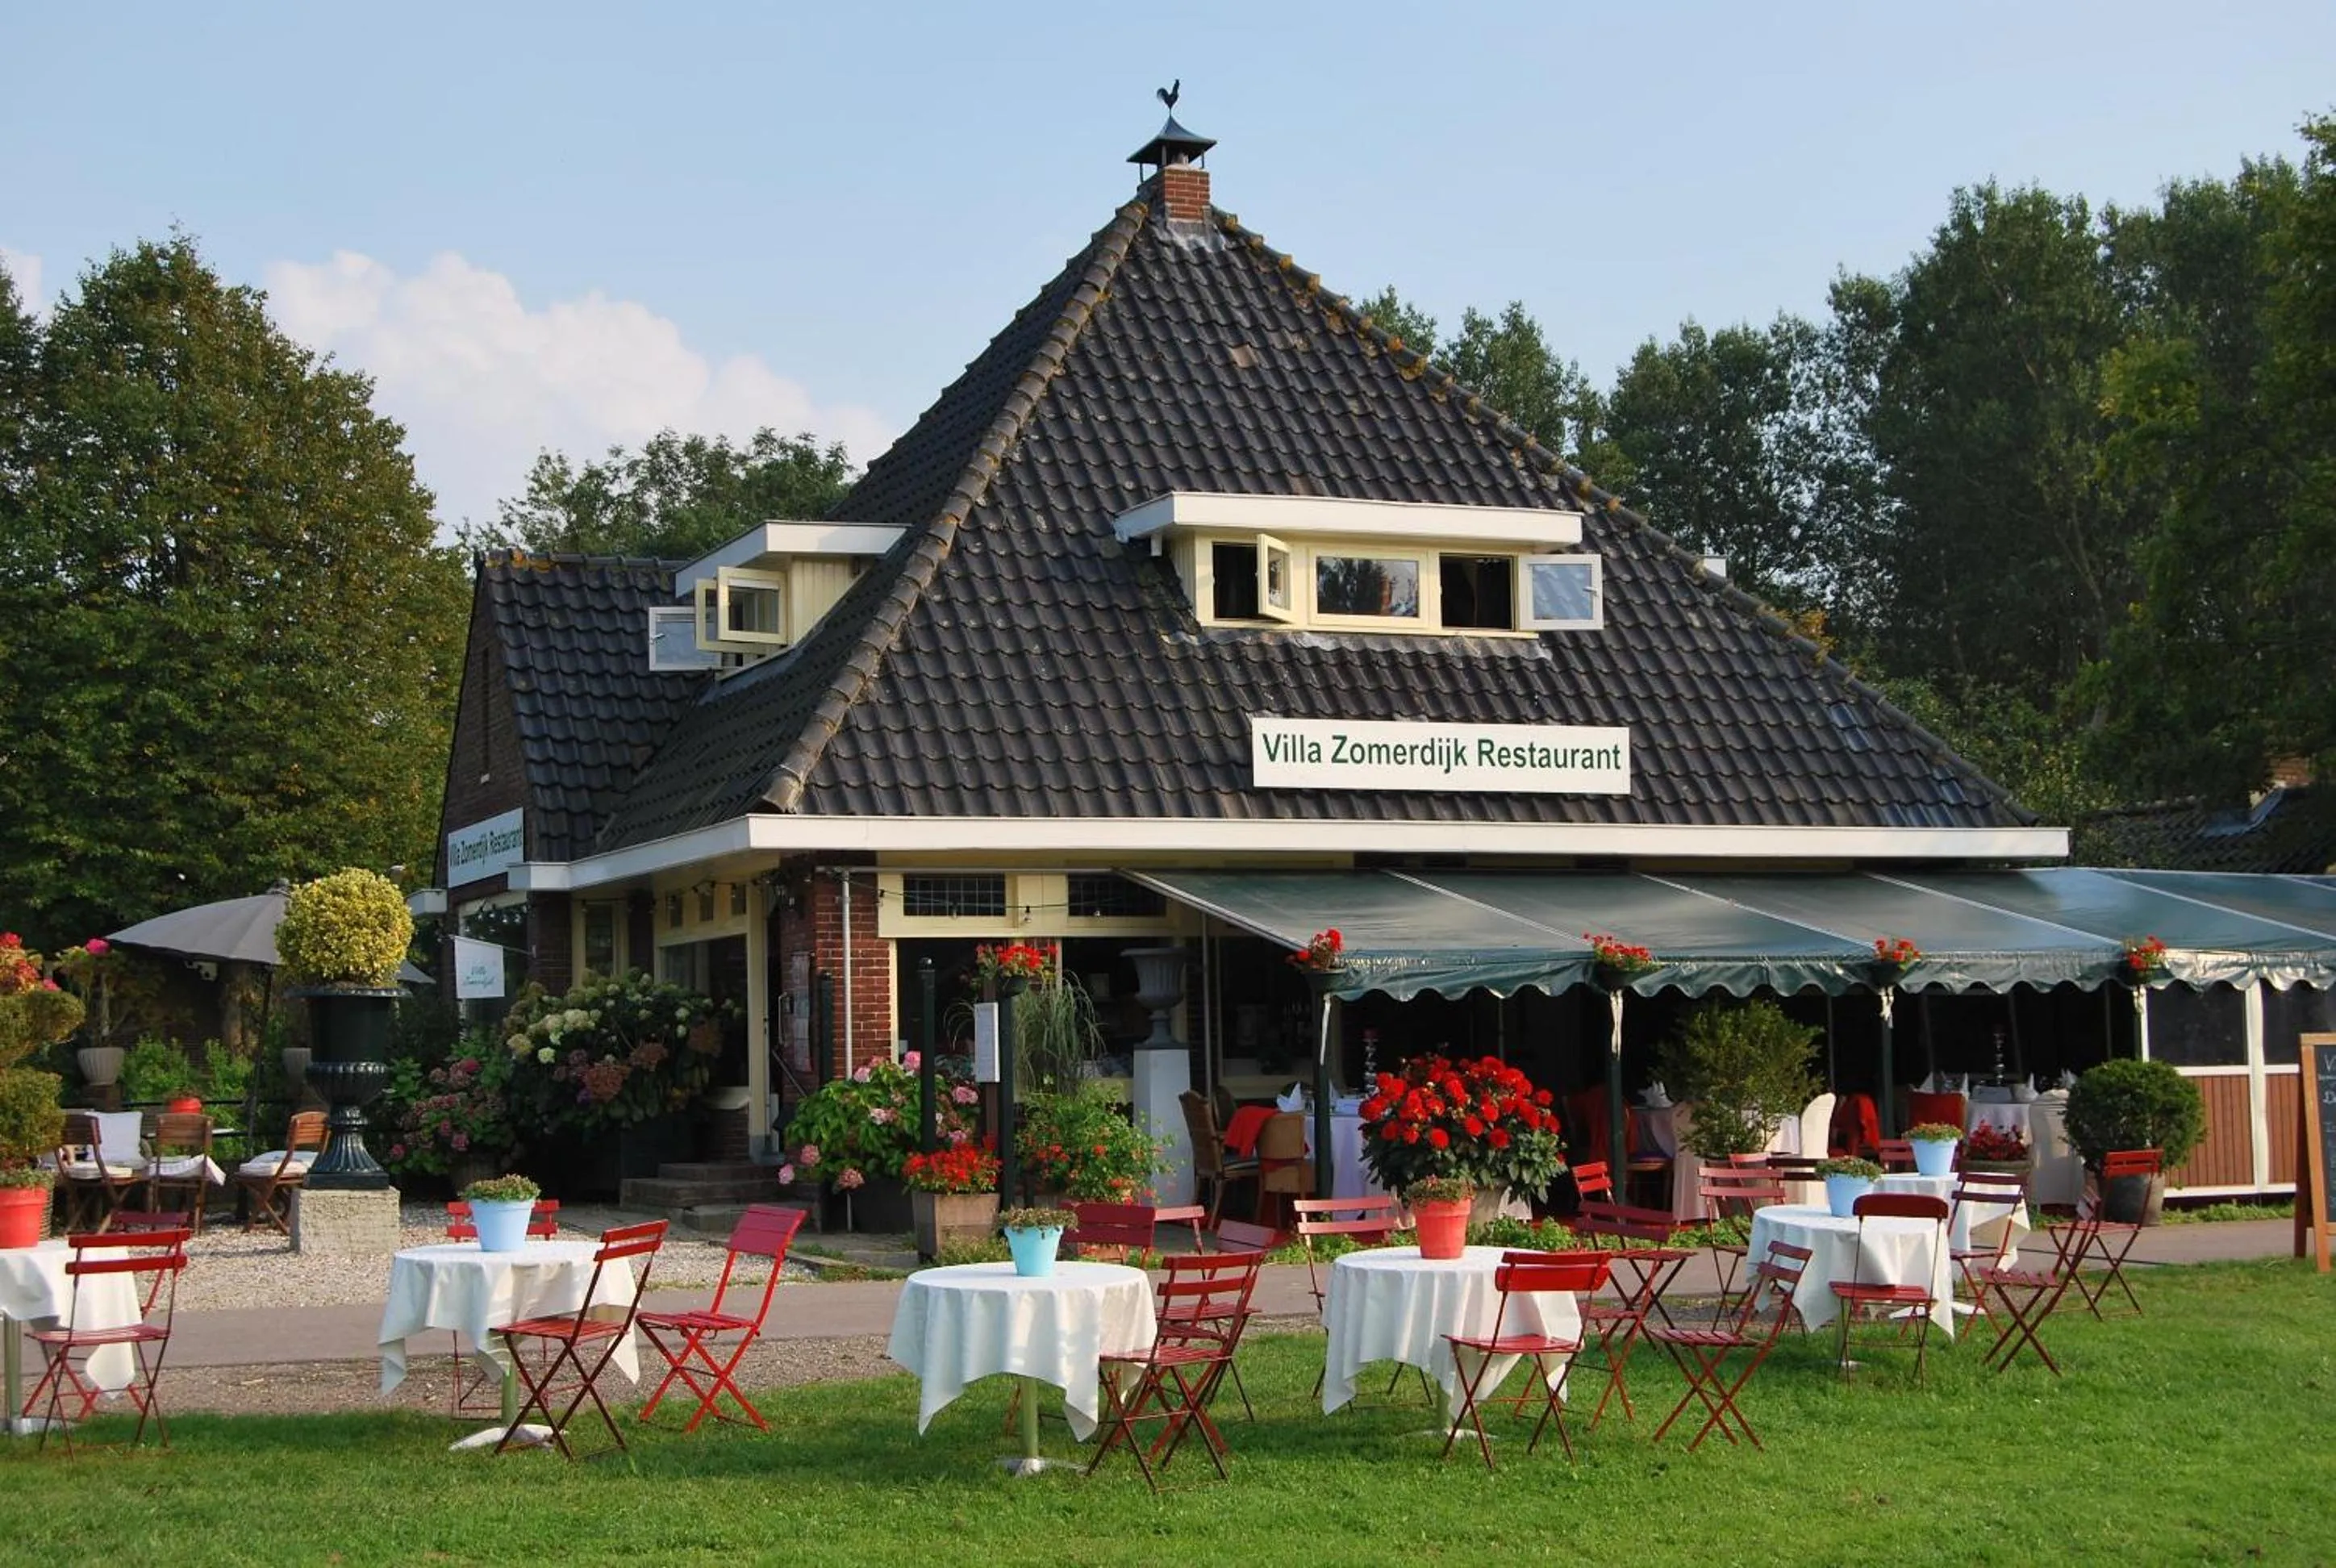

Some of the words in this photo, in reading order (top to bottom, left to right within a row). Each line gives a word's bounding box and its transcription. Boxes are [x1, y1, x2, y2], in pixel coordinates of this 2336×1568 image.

[1262, 733, 1321, 763] Villa
[1331, 735, 1467, 774] Zomerdijk
[1478, 739, 1621, 769] Restaurant
